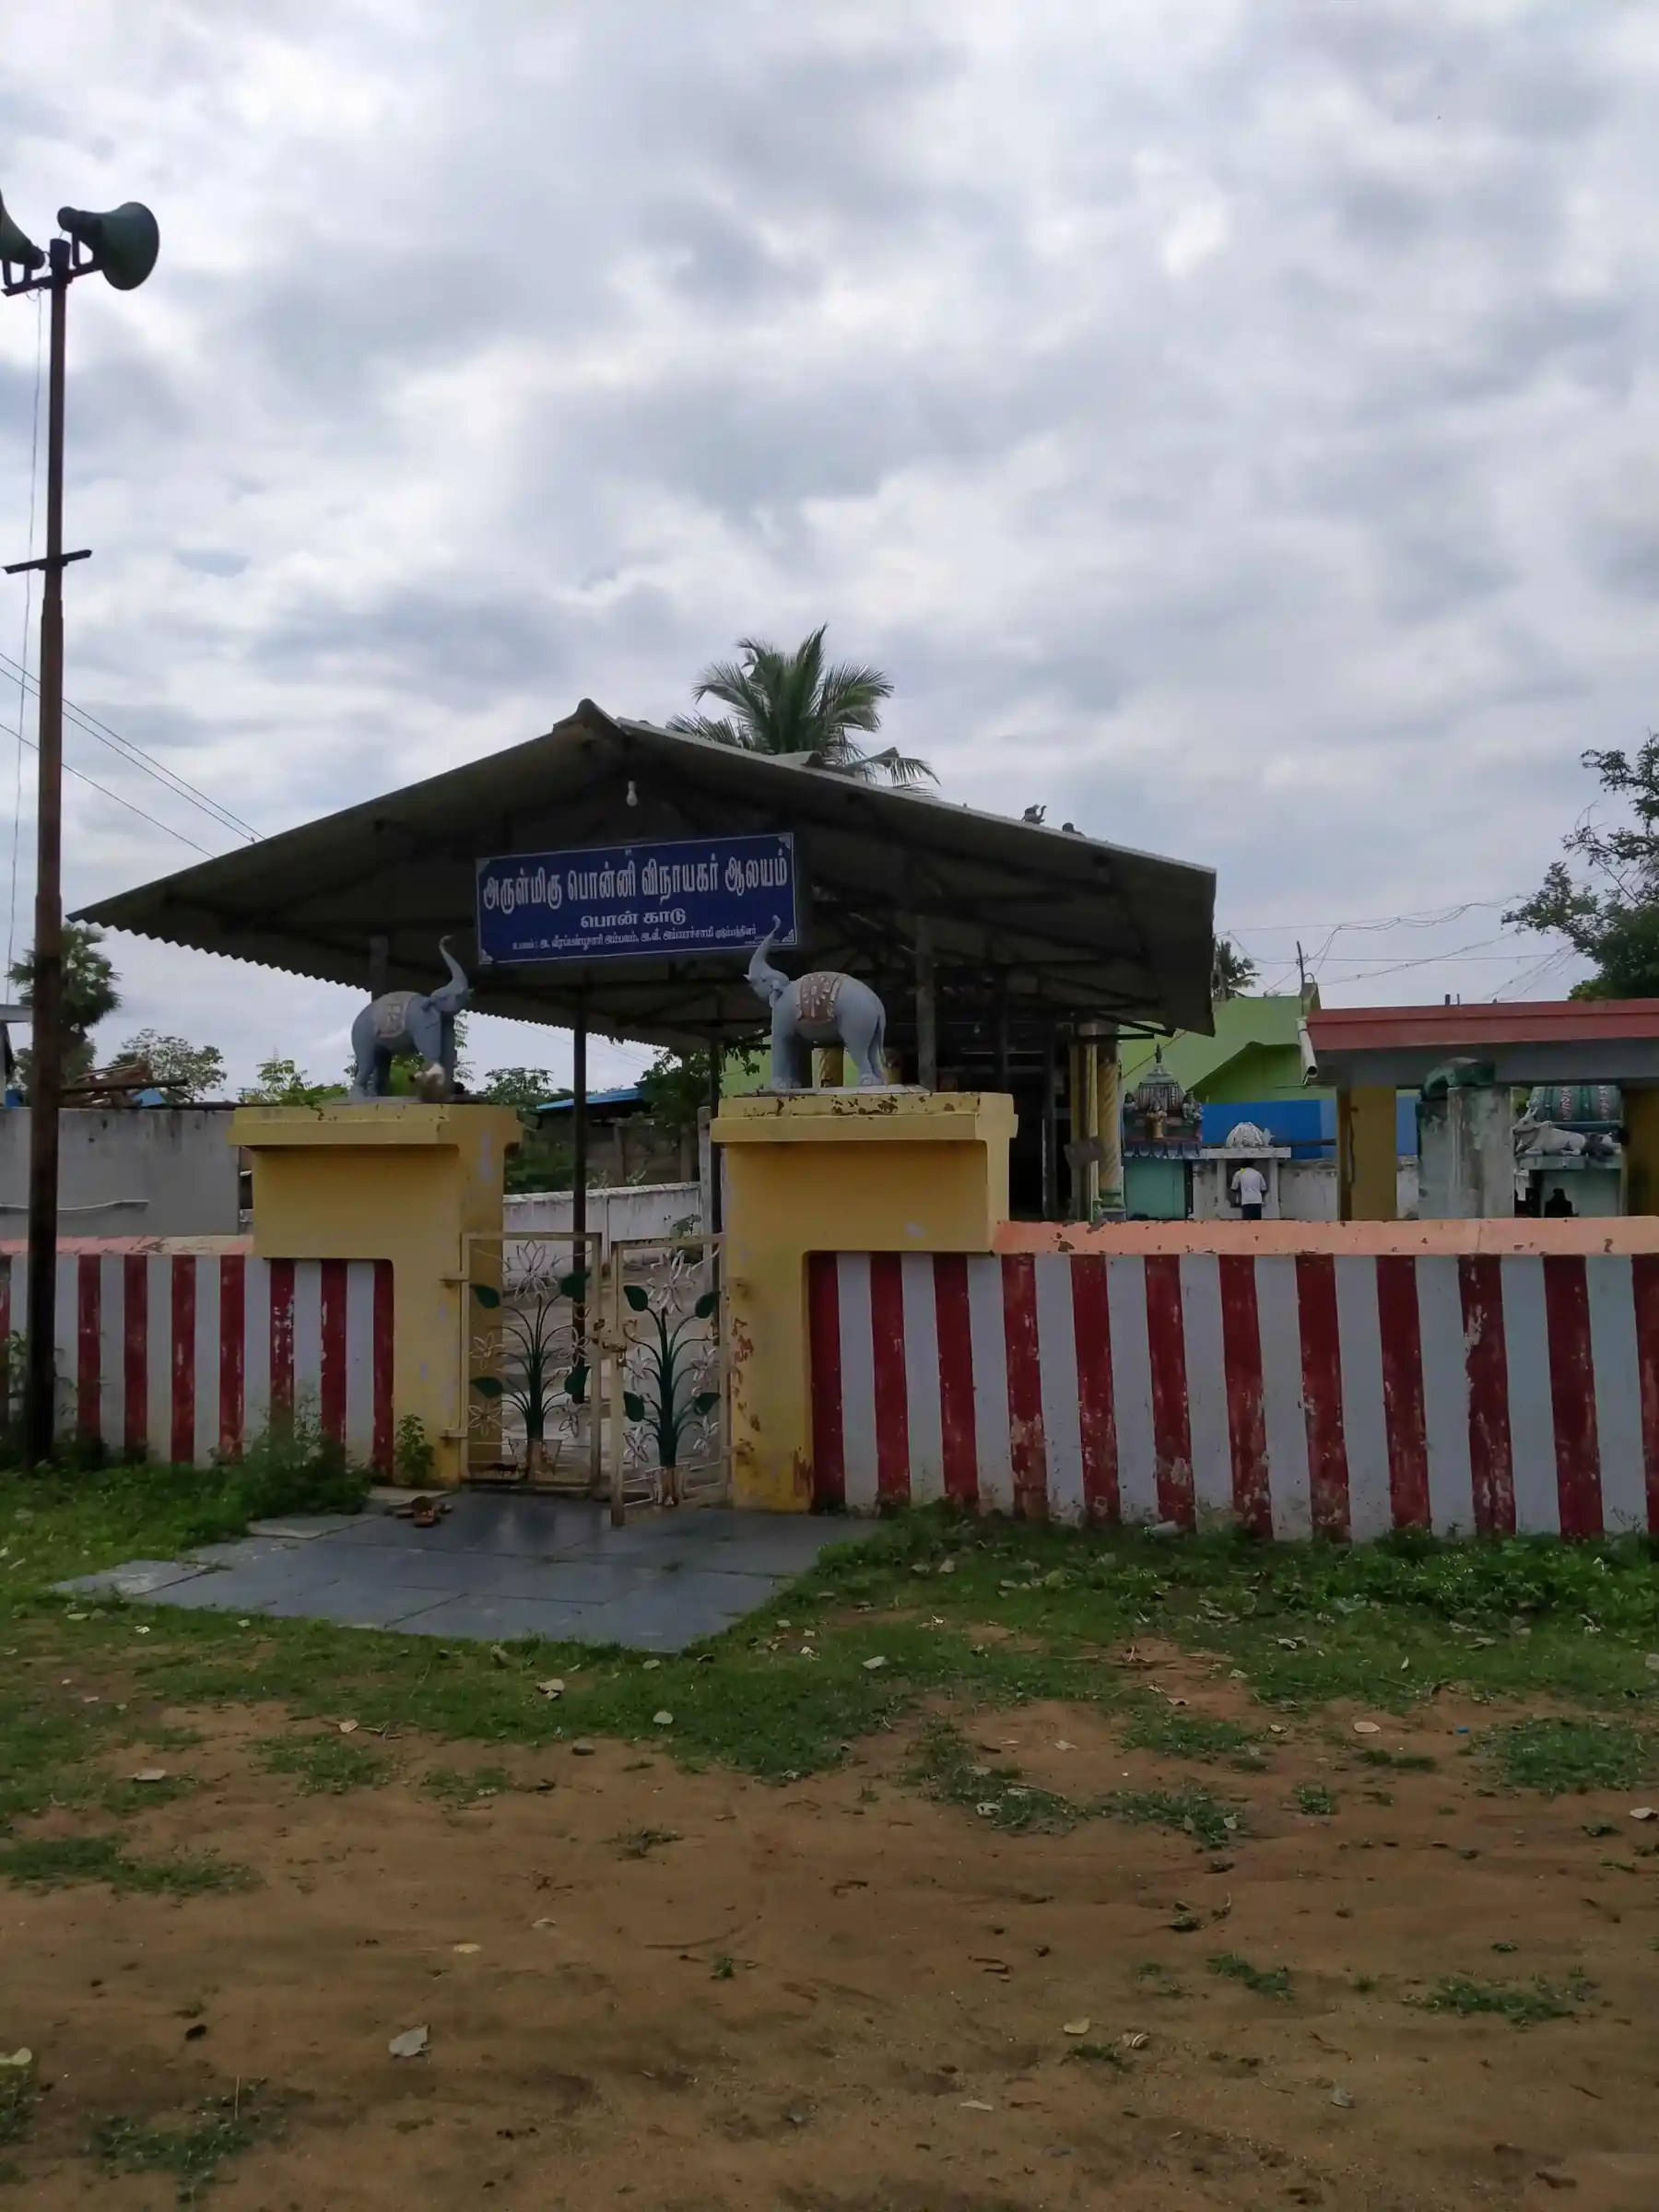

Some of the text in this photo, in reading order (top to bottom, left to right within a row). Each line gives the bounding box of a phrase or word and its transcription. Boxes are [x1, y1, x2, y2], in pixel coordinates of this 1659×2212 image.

[483, 847, 788, 914] அருள்மிகு பொன்னி விநாயகர் ஆலயம்
[581, 908, 687, 928] பொன் காடு
